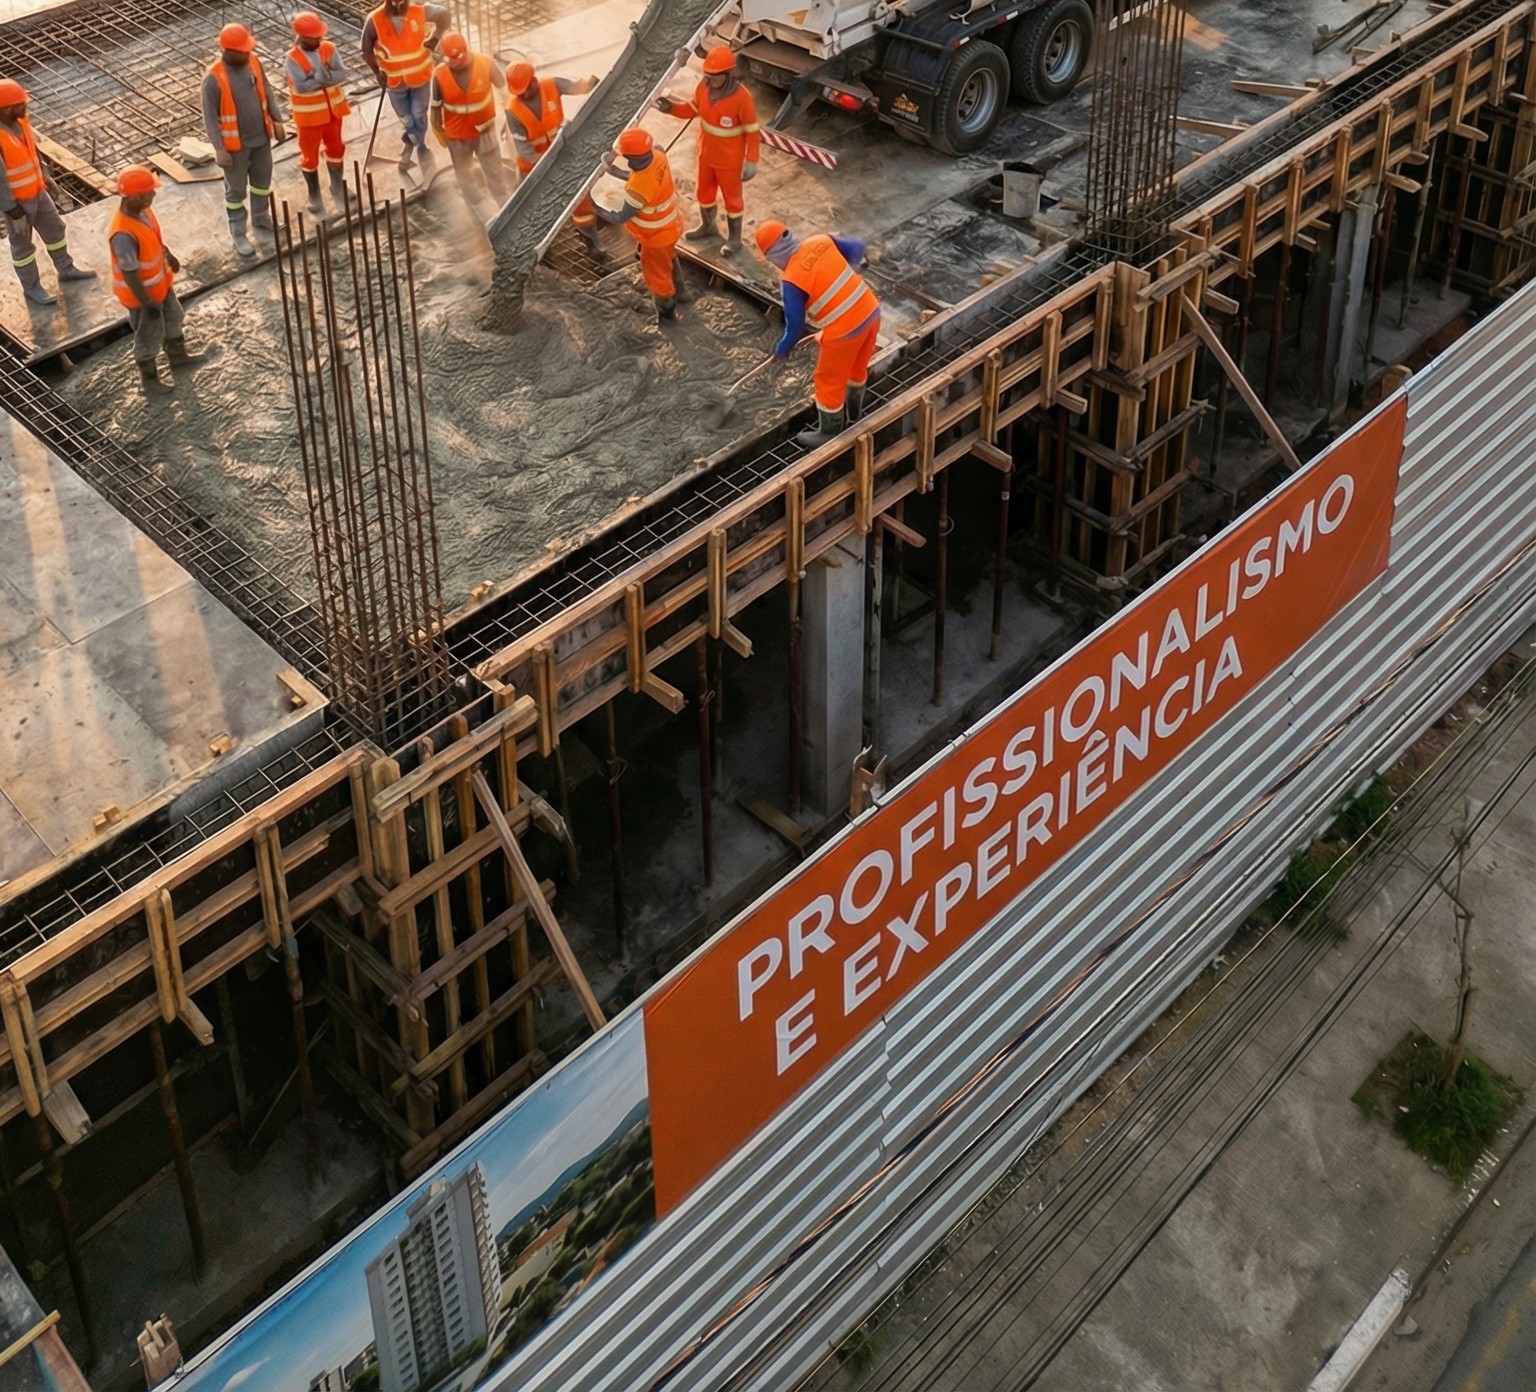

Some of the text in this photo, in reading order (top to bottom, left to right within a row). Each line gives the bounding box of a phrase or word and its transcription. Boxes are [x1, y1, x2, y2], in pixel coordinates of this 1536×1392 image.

[737, 474, 1354, 1021] PROFISSIONALISMO
[776, 636, 1243, 1076] E EXPERIÊNCIA
